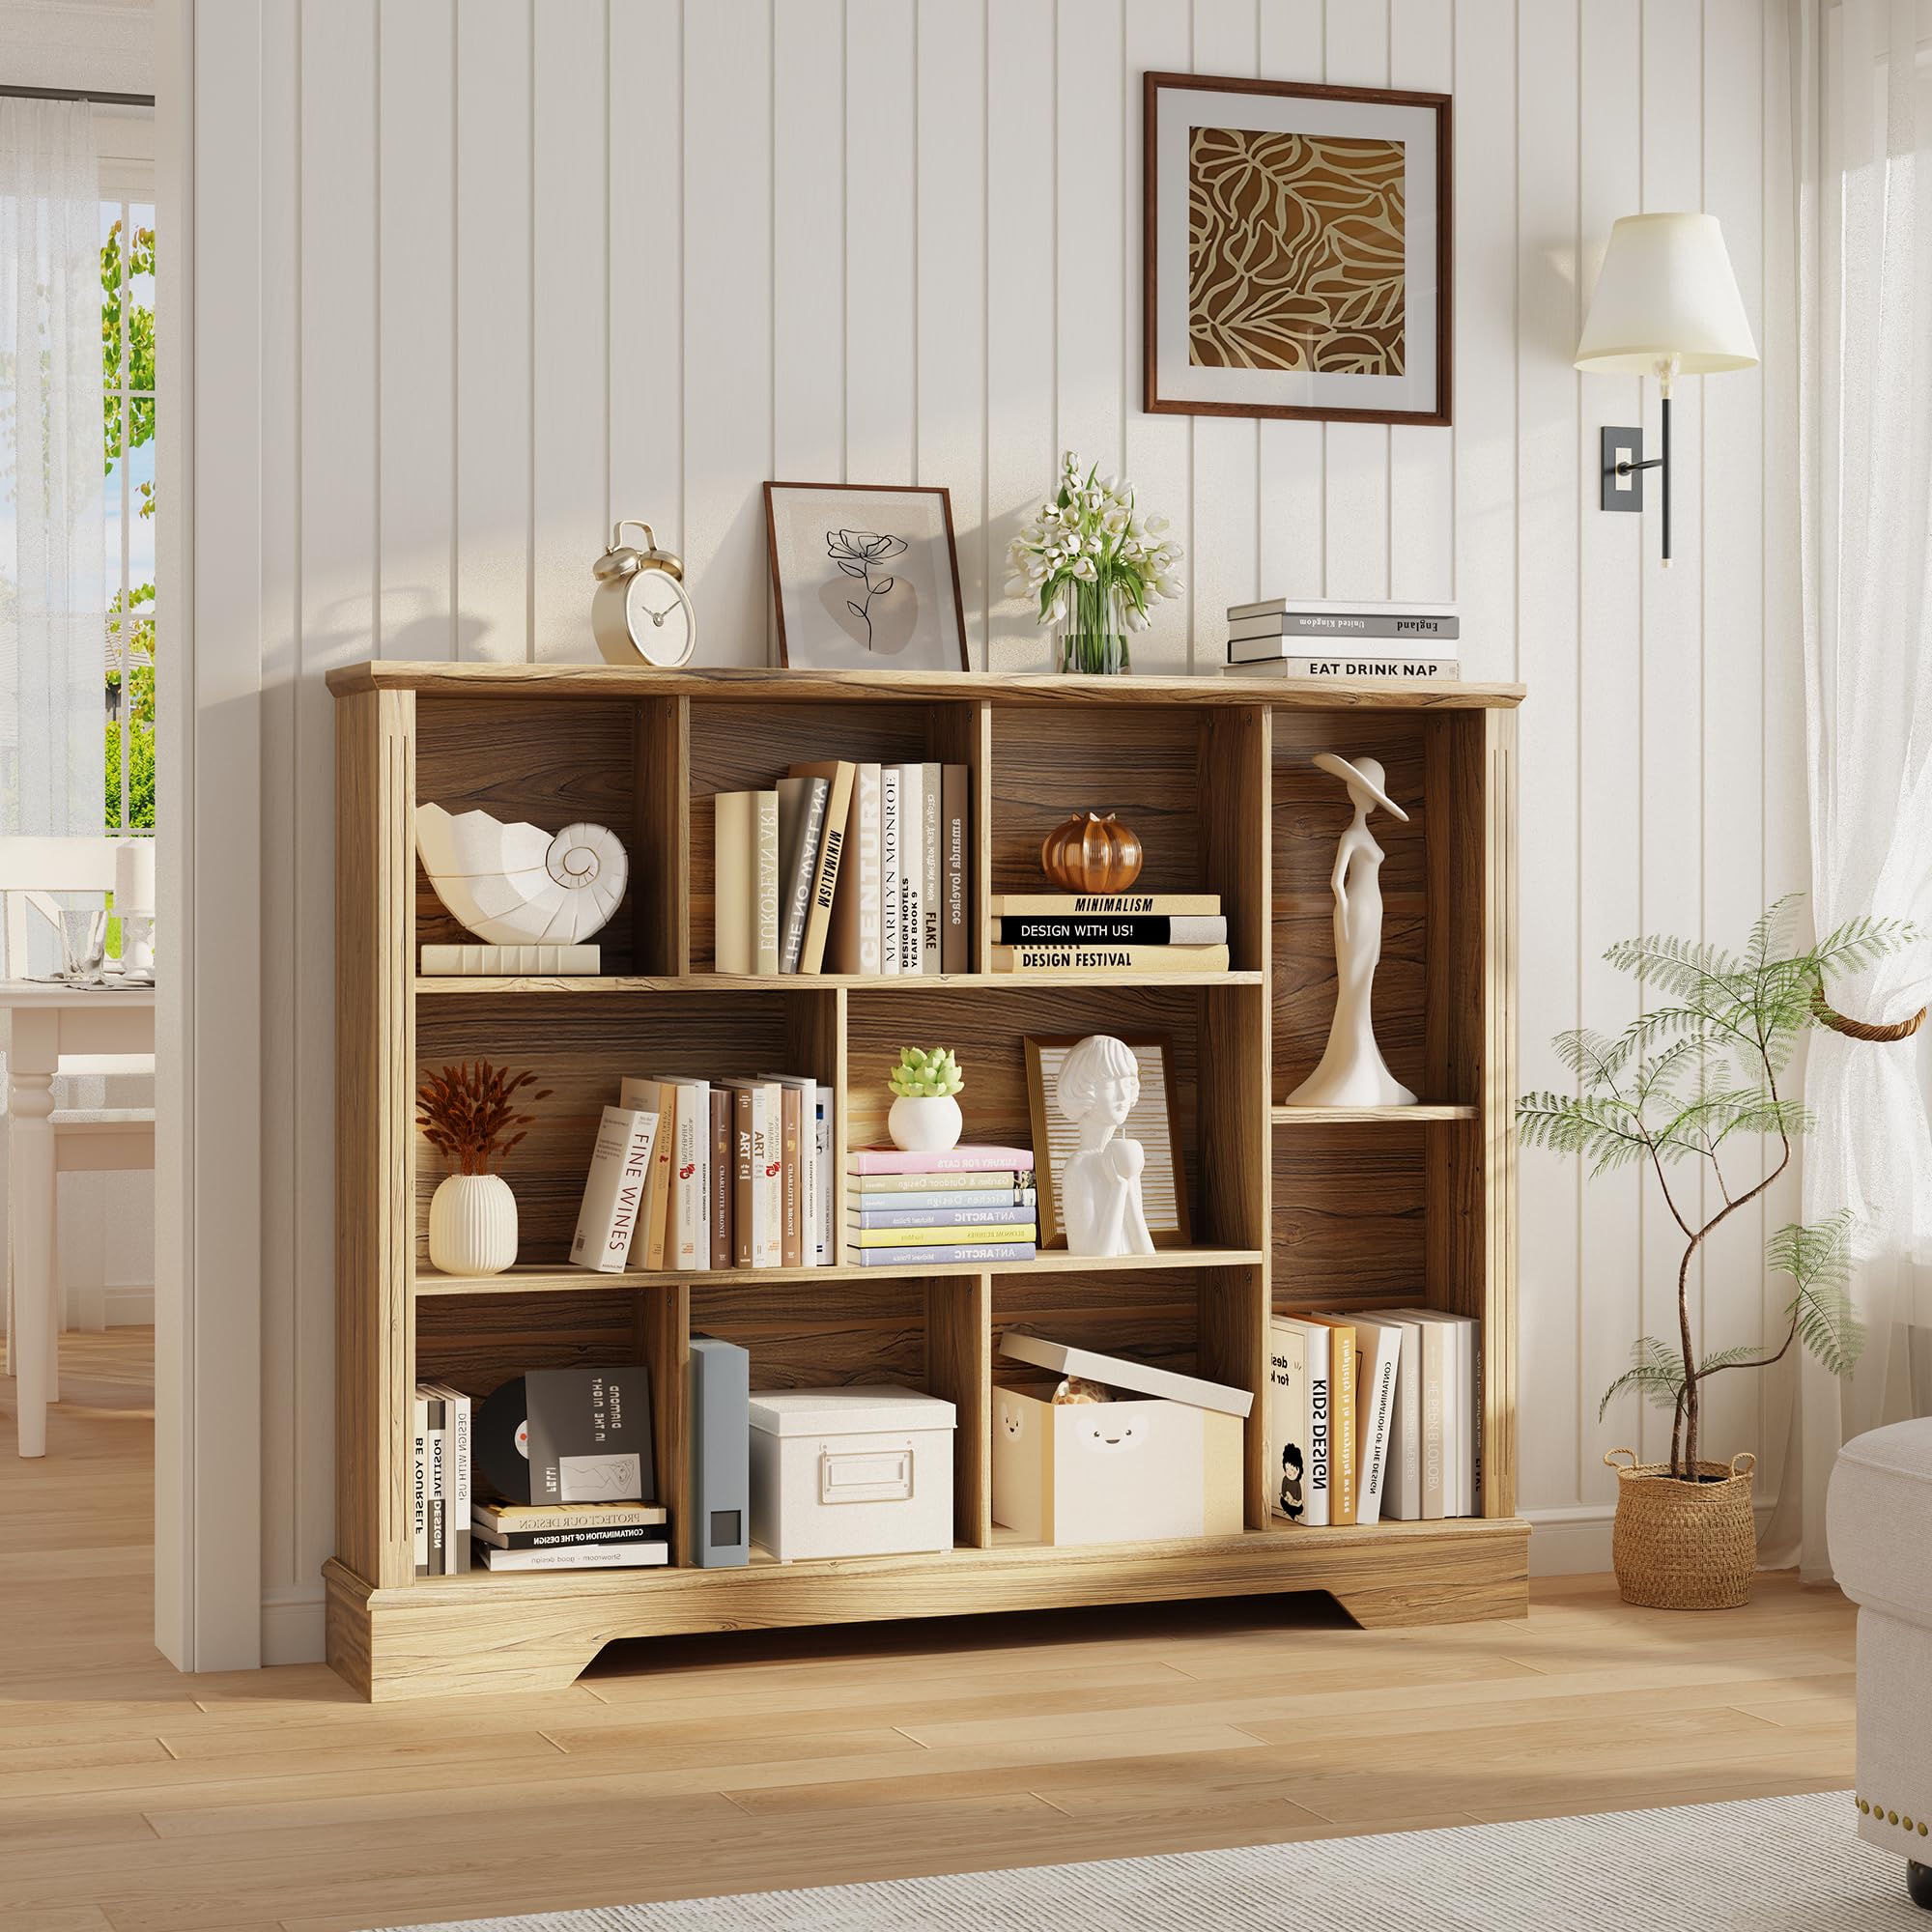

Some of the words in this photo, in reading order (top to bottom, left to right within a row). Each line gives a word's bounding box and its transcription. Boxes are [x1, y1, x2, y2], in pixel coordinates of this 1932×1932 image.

[1298, 619, 1336, 628] Kingdom
[1338, 619, 1365, 629] United
[1397, 619, 1438, 632] England
[1310, 664, 1341, 674] EAT
[1346, 665, 1398, 675] DRINK
[1403, 665, 1437, 676] NAP
[886, 777, 896, 864] MONROE
[817, 829, 842, 908] MINIMALISM
[860, 773, 878, 967] CENTURY
[886, 871, 896, 962] MARILYN
[1075, 898, 1153, 912] MINIMALISM
[925, 912, 936, 949] FLAKE
[1021, 924, 1070, 937] DESIGN
[1074, 924, 1108, 937] WITH
[1112, 924, 1134, 937] US!
[1023, 953, 1070, 967] DESIGN
[1075, 952, 1131, 967] FESTIVAL
[626, 1133, 649, 1178] FINE
[740, 1130, 751, 1159] ART
[754, 1131, 765, 1159] ART
[610, 1186, 638, 1251] WINES
